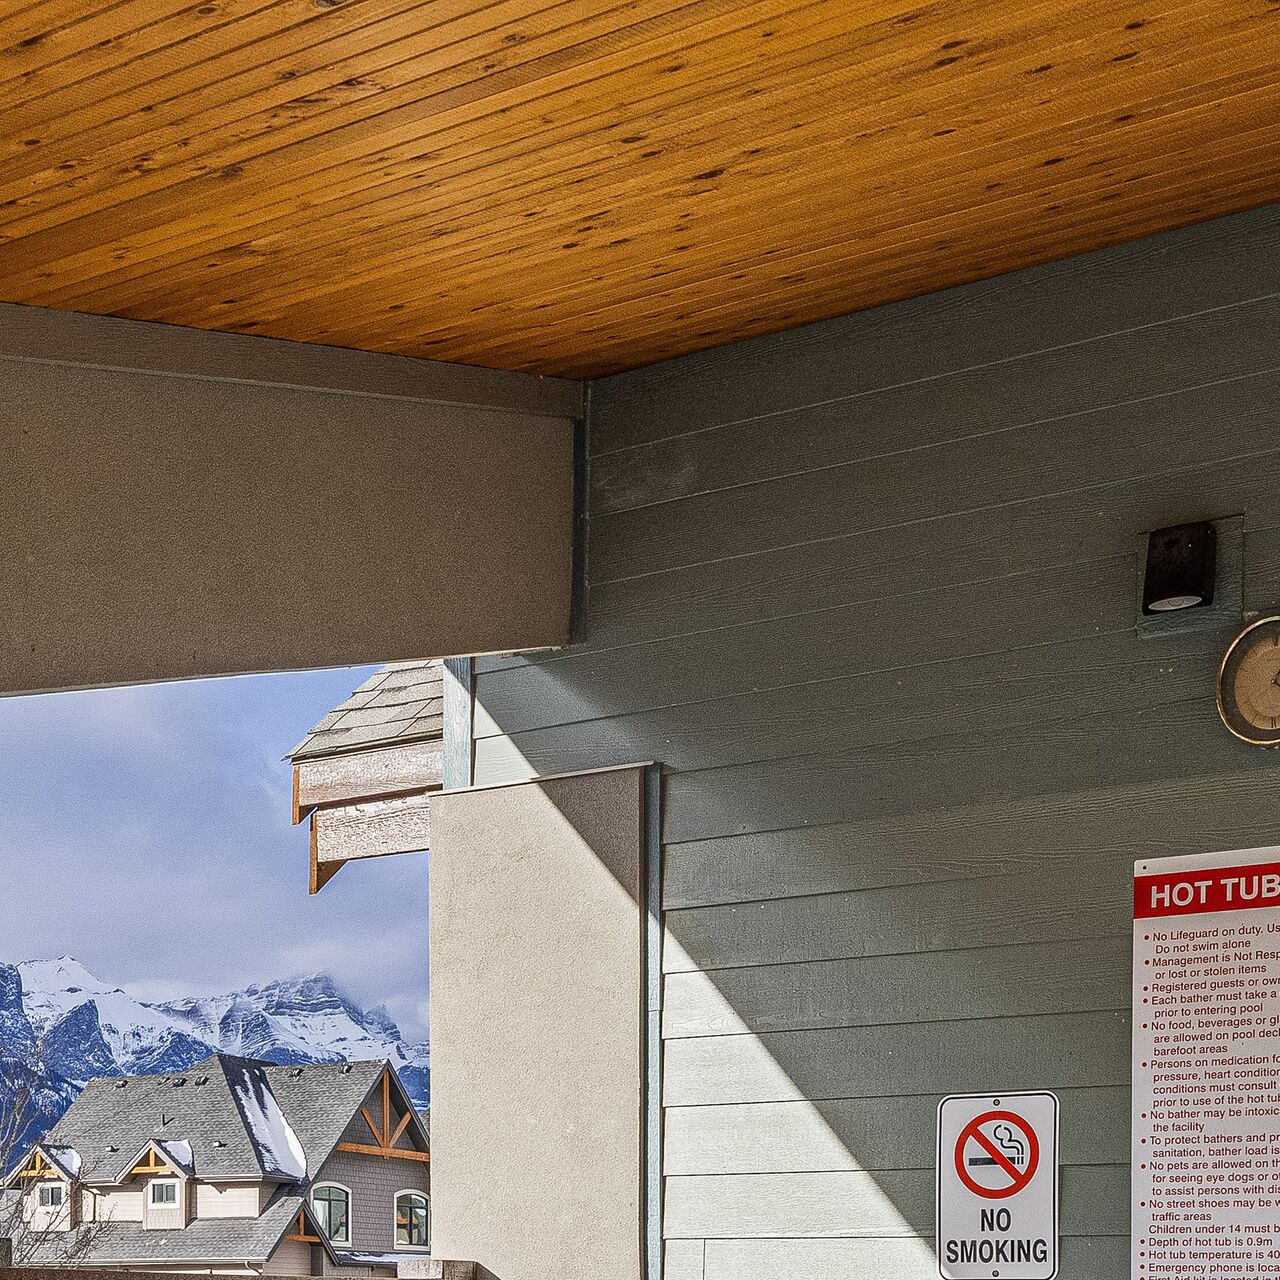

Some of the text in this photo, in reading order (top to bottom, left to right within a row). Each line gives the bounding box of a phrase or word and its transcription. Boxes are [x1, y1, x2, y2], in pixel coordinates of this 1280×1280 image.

[1151, 880, 1212, 908] HOT
[1220, 873, 1280, 901] TUB
[1152, 932, 1167, 941] No
[1170, 927, 1219, 941] Lifeguard
[1221, 928, 1235, 936] on
[1238, 925, 1263, 936] duty.
[1155, 939, 1251, 954] Do not swim alone
[1152, 953, 1219, 967] Management
[1221, 952, 1230, 962] is
[1233, 951, 1252, 961] Not
[1151, 980, 1206, 994] Registered
[1209, 978, 1245, 991] guests
[1247, 978, 1259, 986] or
[1151, 994, 1177, 1005] Each
[1180, 993, 1213, 1004] bather
[1216, 991, 1242, 1001] must
[1244, 989, 1267, 1000] take
[1270, 990, 1277, 998] a
[1151, 1021, 1165, 1031] No
[1168, 1019, 1194, 1030] food,
[1197, 1017, 1252, 1029] beverages
[1255, 1017, 1267, 1025] or
[1150, 1059, 1192, 1069] Persons
[1194, 1059, 1208, 1067] on
[1211, 1054, 1269, 1066] medication
[1153, 1072, 1201, 1084] pressure,
[1204, 1069, 1231, 1079] heart
[1150, 1110, 1164, 1119] No
[1167, 1109, 1200, 1119] bather
[1203, 1110, 1225, 1119] may
[1228, 1107, 1242, 1117] be
[1152, 1121, 1205, 1133] the facility
[1149, 1135, 1161, 1145] To
[1164, 1135, 1200, 1147] protect
[1203, 1133, 1243, 1143] bathers
[1245, 1132, 1266, 1142] and
[1149, 1161, 1164, 1170] No
[1167, 1161, 1189, 1172] pets
[1191, 1161, 1208, 1170] are
[1211, 1158, 1252, 1169] allowed
[1255, 1160, 1268, 1168] on
[1152, 1187, 1162, 1196] to
[1164, 1185, 1194, 1196] assist
[1197, 1186, 1240, 1197] persons
[1242, 1184, 1264, 1194] with
[1149, 1199, 1164, 1209] No
[1166, 1199, 1195, 1208] street
[1198, 1198, 1230, 1208] shoes
[1232, 1199, 1255, 1210] may
[1258, 1197, 1272, 1207] be
[981, 1208, 1011, 1232] NO
[1151, 1211, 1212, 1221] traffic areas
[1148, 1224, 1192, 1234] Children
[1194, 1224, 1225, 1234] under
[1228, 1224, 1241, 1233] 14
[1244, 1224, 1270, 1233] must
[1148, 1236, 1272, 1248] Depth of hot tub is 0.9m
[946, 1239, 1047, 1263] SMOKING
[1148, 1250, 1166, 1259] Hot
[1169, 1250, 1186, 1259] tub
[1188, 1250, 1252, 1261] temperature
[1255, 1249, 1264, 1259] is
[1148, 1262, 1207, 1274] Emergency
[1209, 1262, 1243, 1274] phone
[1245, 1262, 1255, 1272] is
